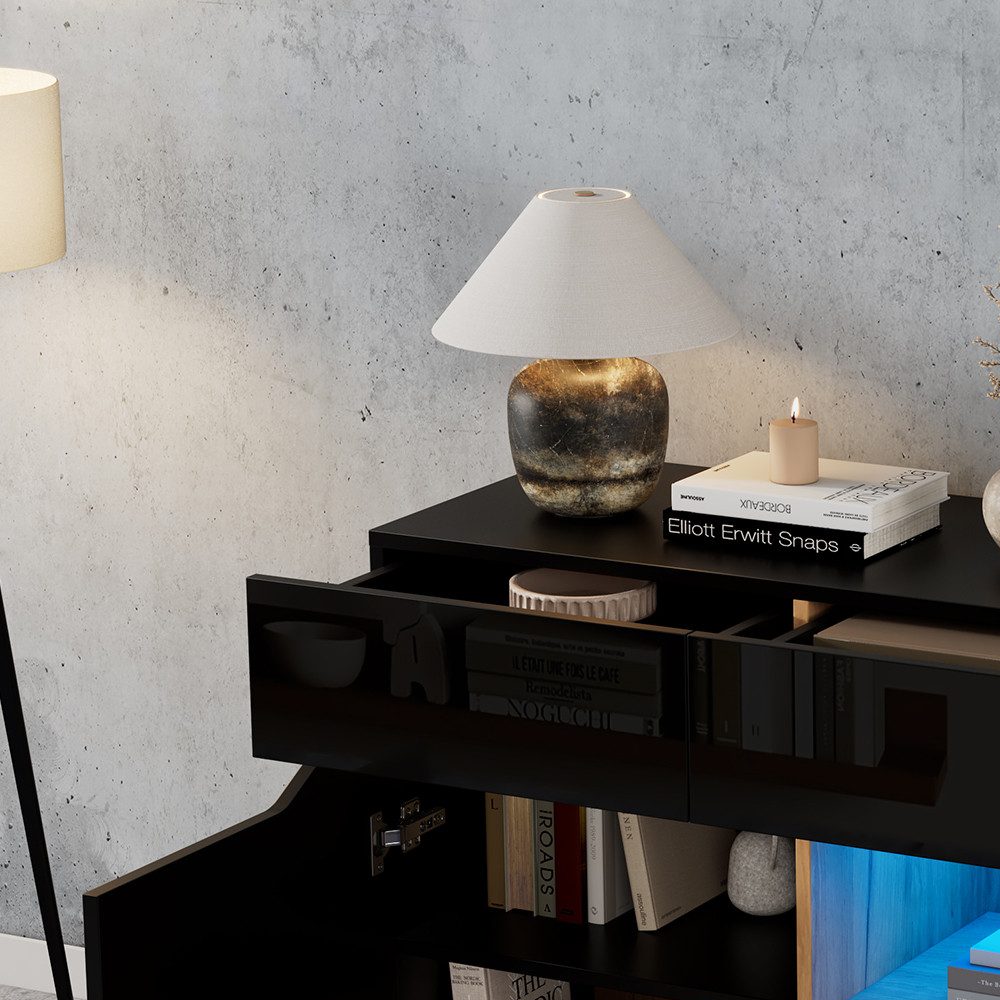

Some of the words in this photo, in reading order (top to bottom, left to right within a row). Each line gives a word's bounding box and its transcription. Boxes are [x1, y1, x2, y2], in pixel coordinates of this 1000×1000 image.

[740, 498, 792, 514] BORDEAUX
[668, 517, 715, 538] Elliott
[721, 524, 773, 545] Erwitt
[778, 531, 839, 553] Snaps
[526, 679, 592, 701] Remodelista
